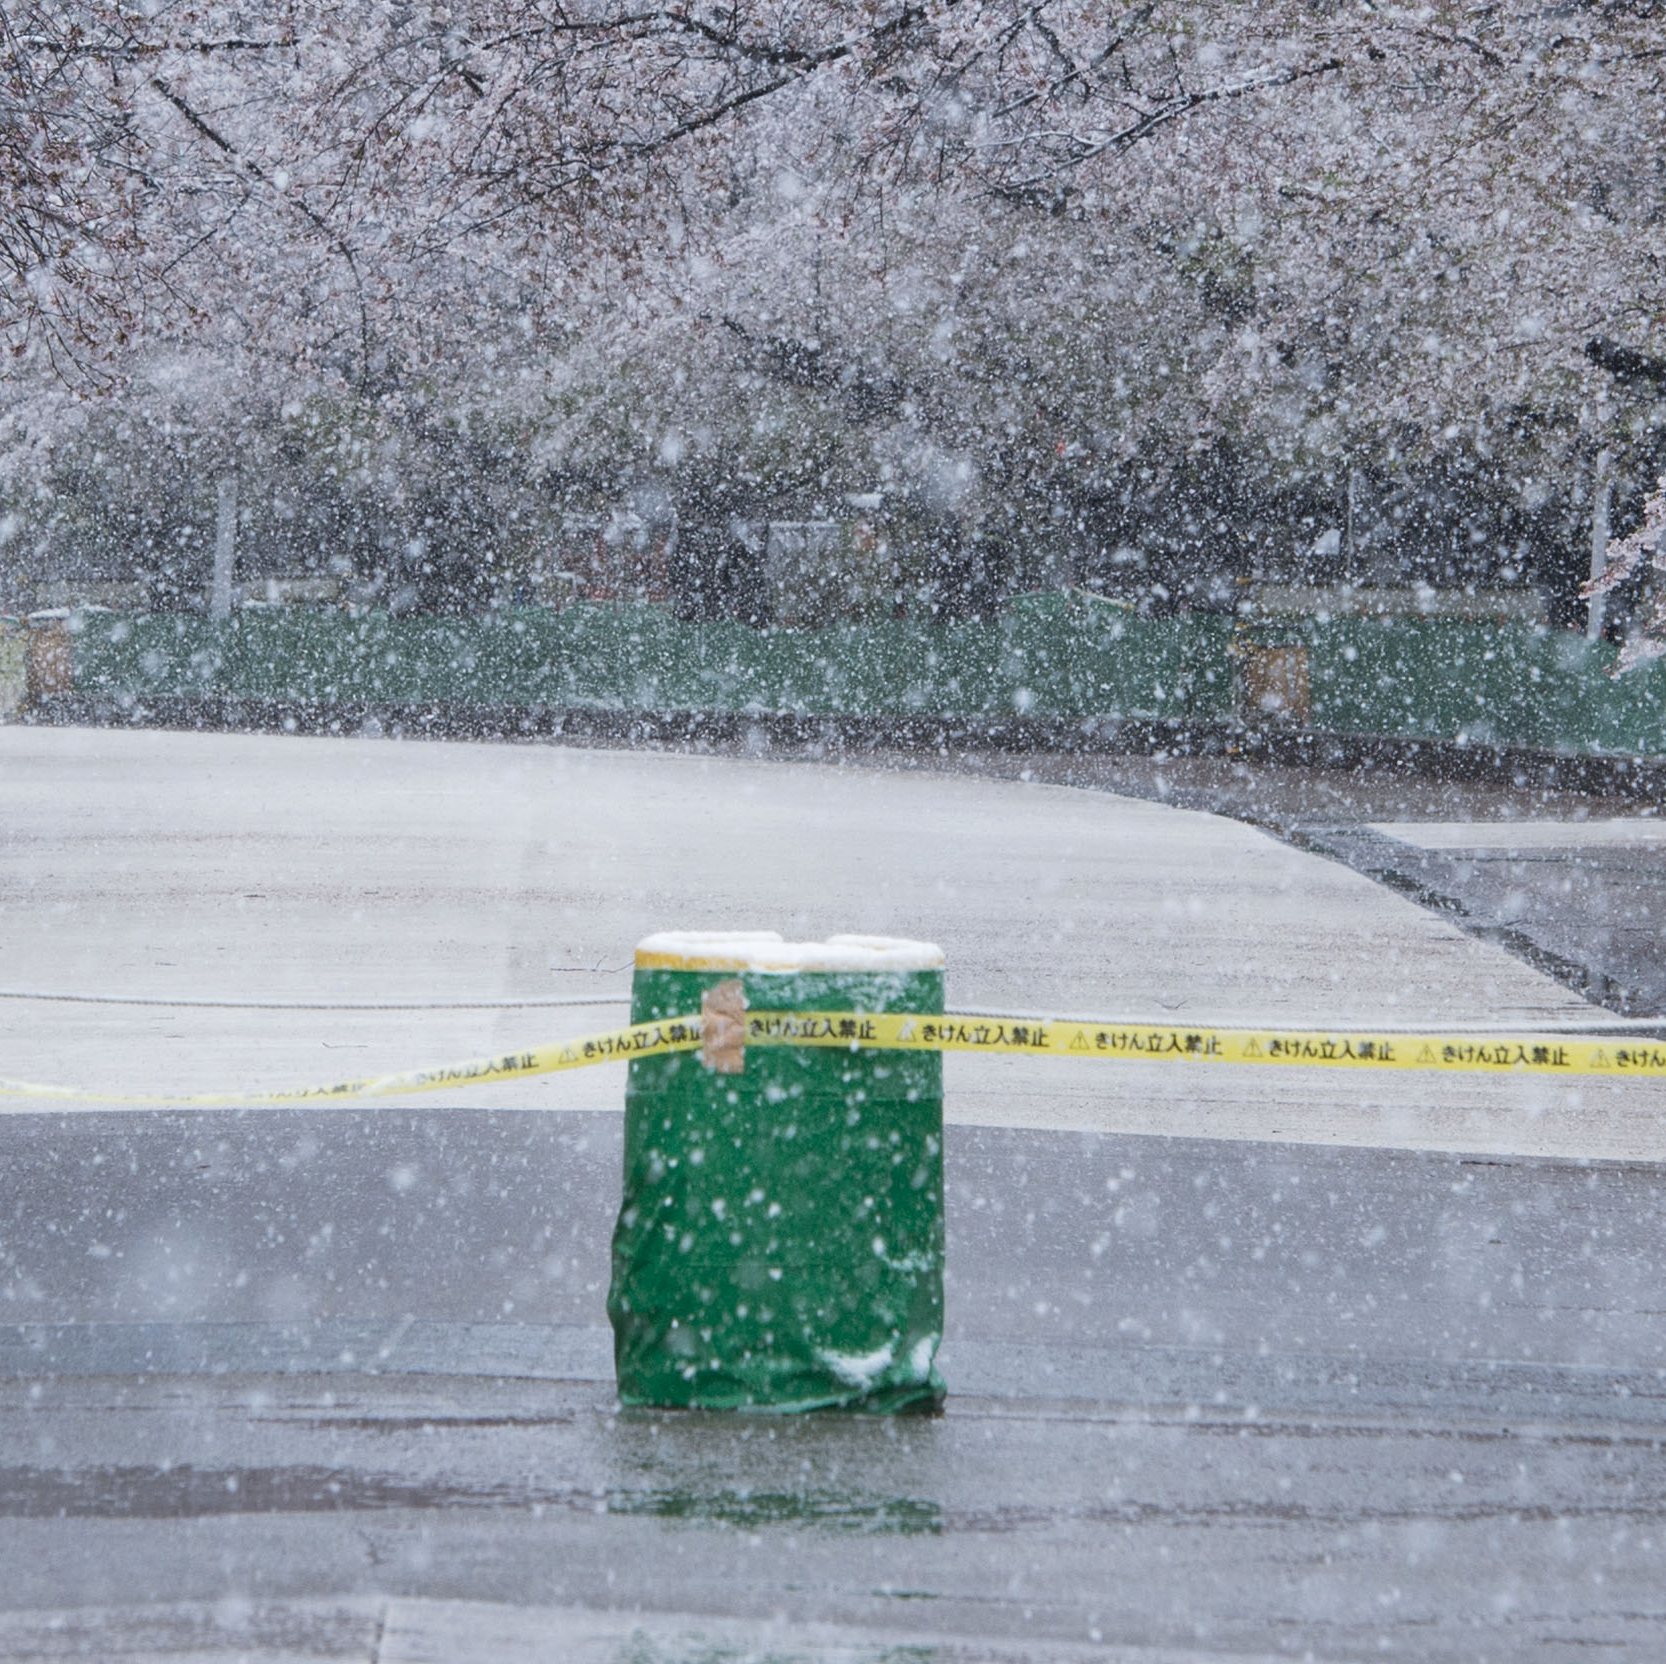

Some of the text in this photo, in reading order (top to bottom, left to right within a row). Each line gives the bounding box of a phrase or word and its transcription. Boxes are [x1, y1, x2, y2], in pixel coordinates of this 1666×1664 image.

[749, 1018, 876, 1040] きけん立入禁止
[923, 1024, 1049, 1047] きけん立入禁止
[1095, 1033, 1222, 1056] きけん立入禁止
[1269, 1039, 1396, 1061] きけん立入禁止
[1442, 1045, 1571, 1067] きけん立入禁止
